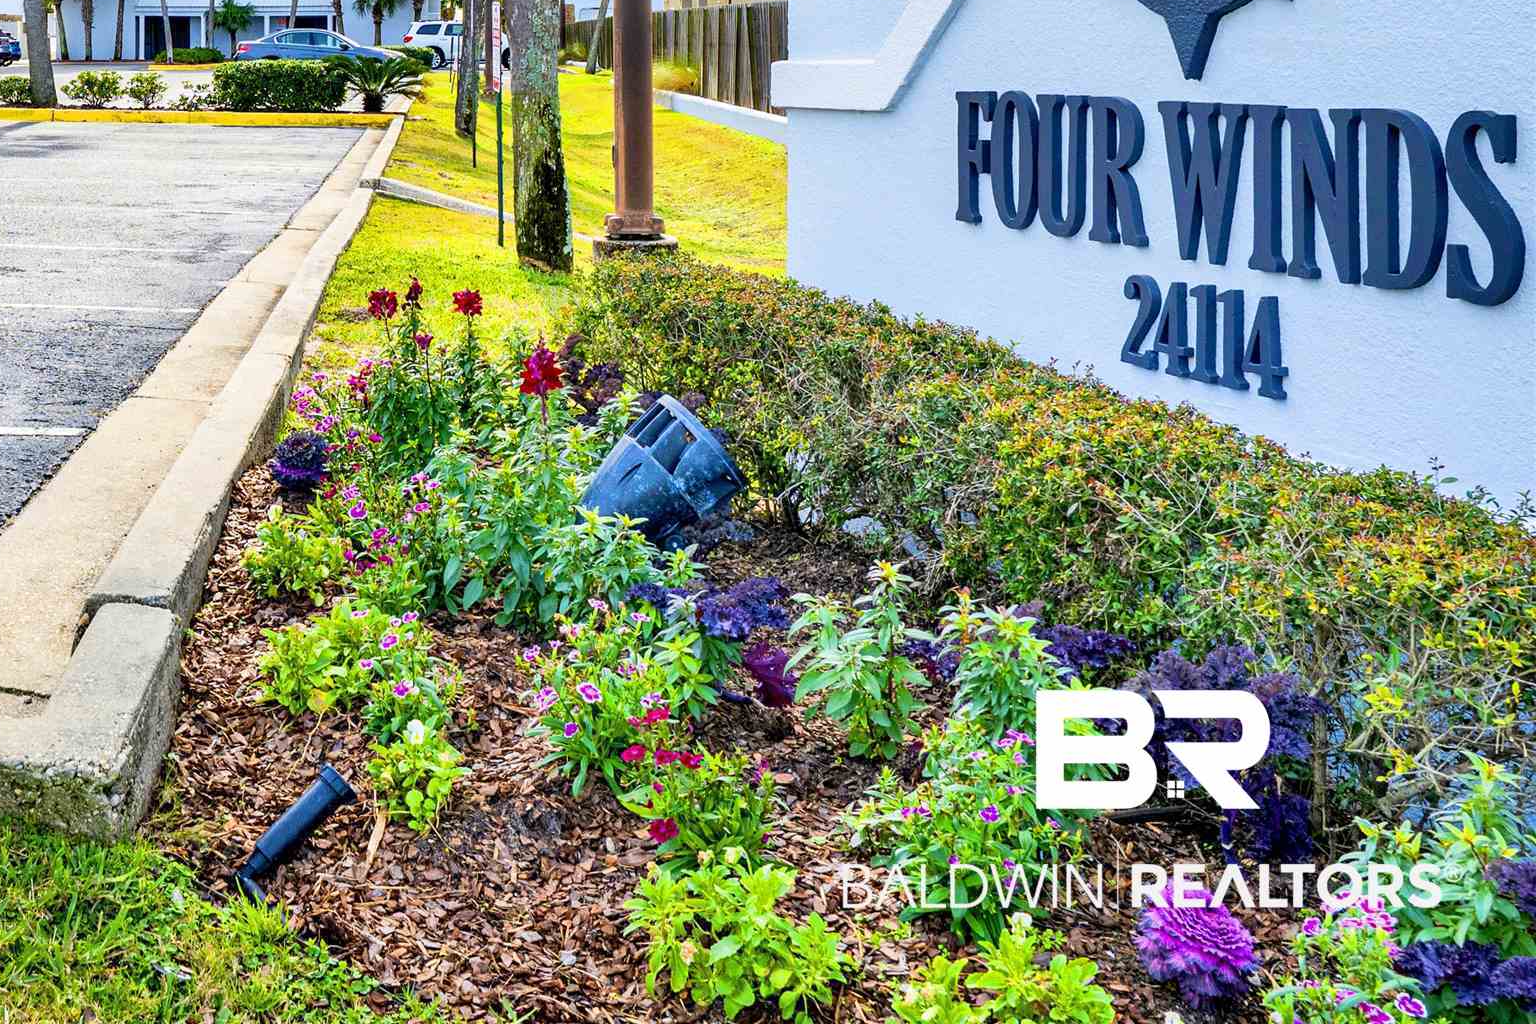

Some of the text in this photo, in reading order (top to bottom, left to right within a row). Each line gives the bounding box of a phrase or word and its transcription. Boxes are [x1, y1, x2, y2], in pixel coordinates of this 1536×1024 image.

[956, 90, 1526, 306] FOUR WINDS
[1120, 273, 1289, 400] 24114
